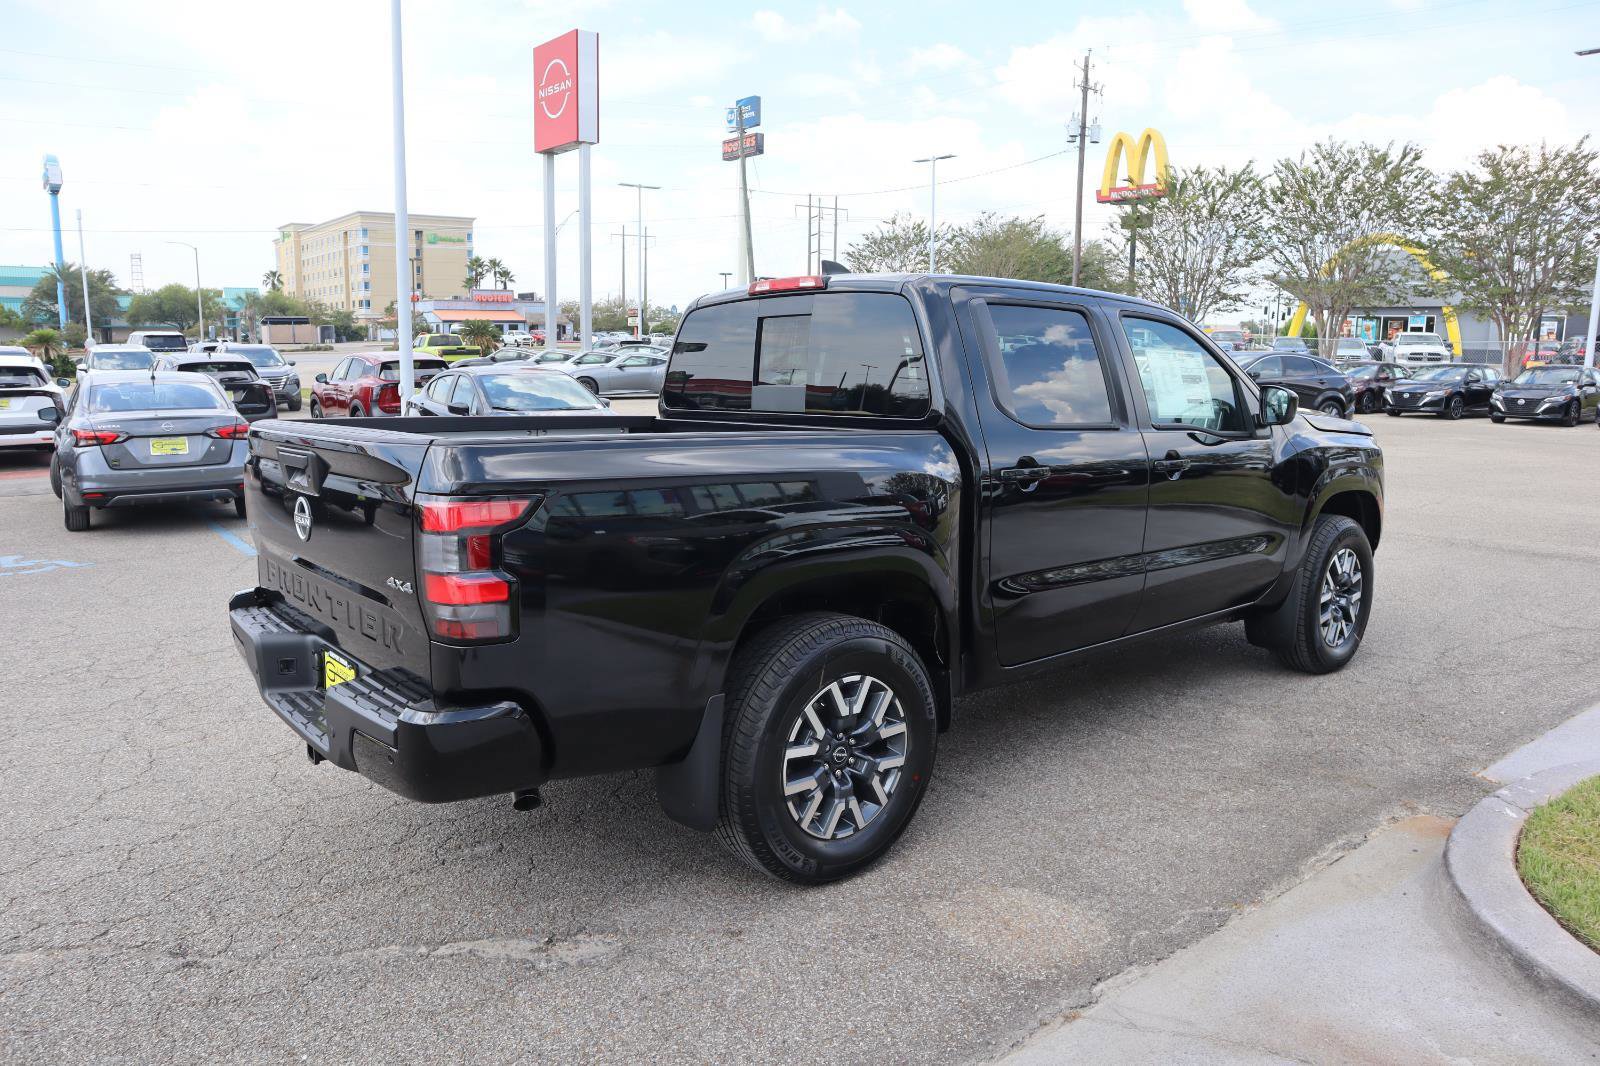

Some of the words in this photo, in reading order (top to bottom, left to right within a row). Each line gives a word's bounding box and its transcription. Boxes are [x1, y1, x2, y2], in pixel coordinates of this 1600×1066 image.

[538, 79, 572, 99] NISSAN
[723, 136, 756, 153] HOOERS
[266, 559, 405, 656] FRONTIER
